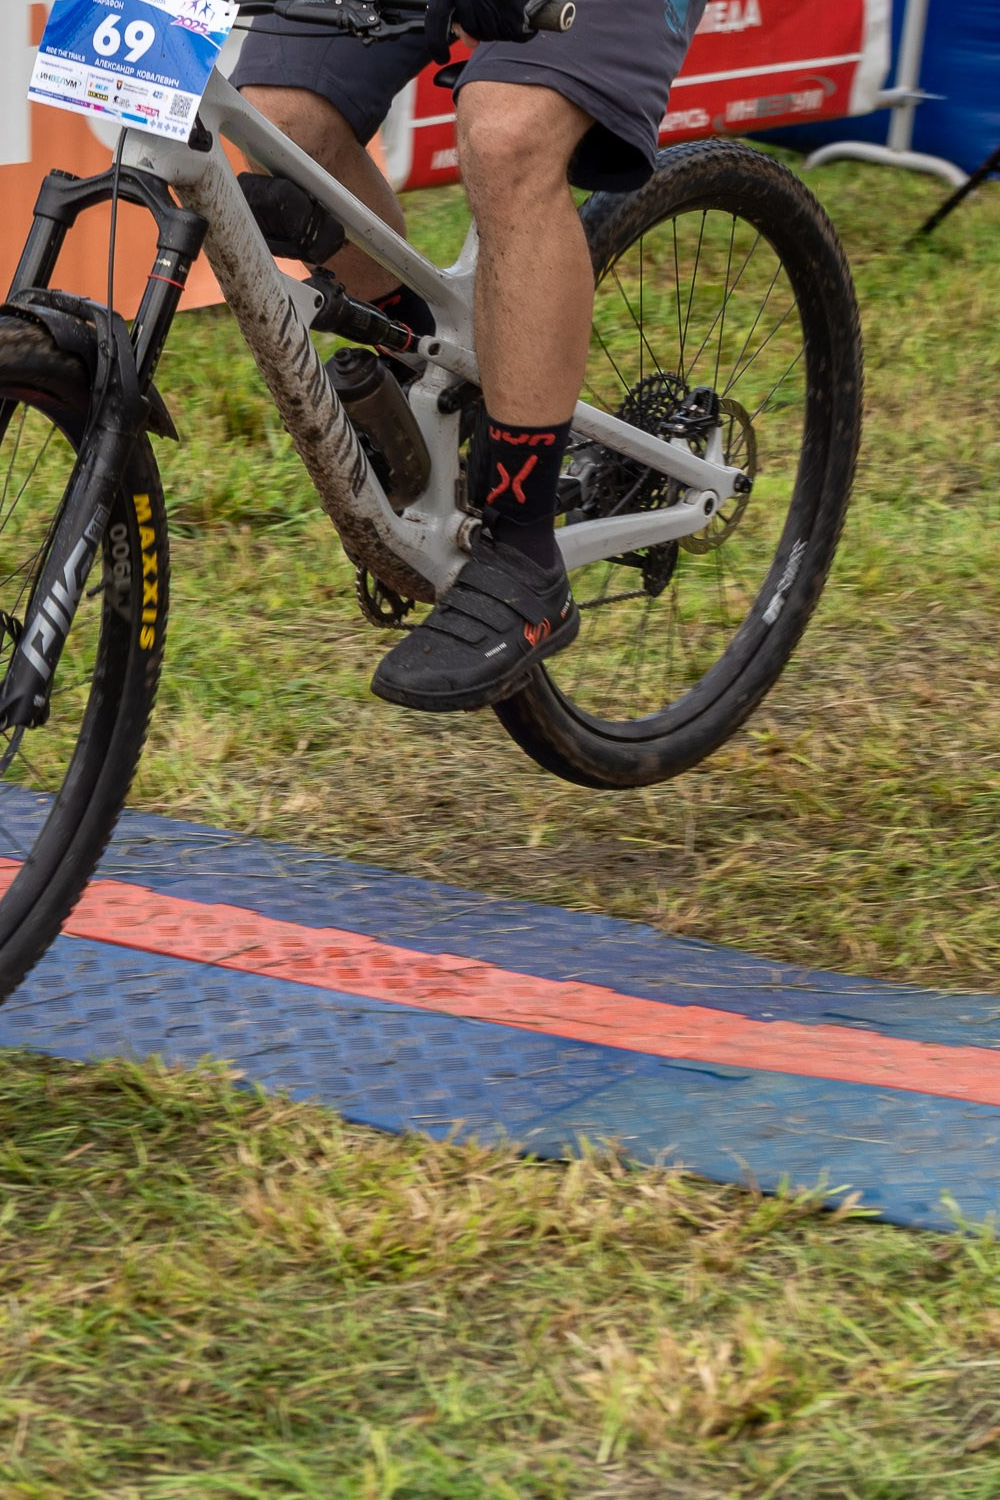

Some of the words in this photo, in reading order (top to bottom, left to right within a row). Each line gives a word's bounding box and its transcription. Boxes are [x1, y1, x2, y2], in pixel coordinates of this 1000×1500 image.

[93, 13, 155, 63] 69
[175, 14, 210, 36] 2025
[46, 45, 58, 56] RIDE
[58, 48, 68, 58] THE
[68, 51, 86, 62] TRAILS
[95, 58, 135, 74] АЛЕКСАНДР
[136, 69, 180, 88] КОВАЛЕВИЧ
[132, 493, 157, 651] MAXXIS
